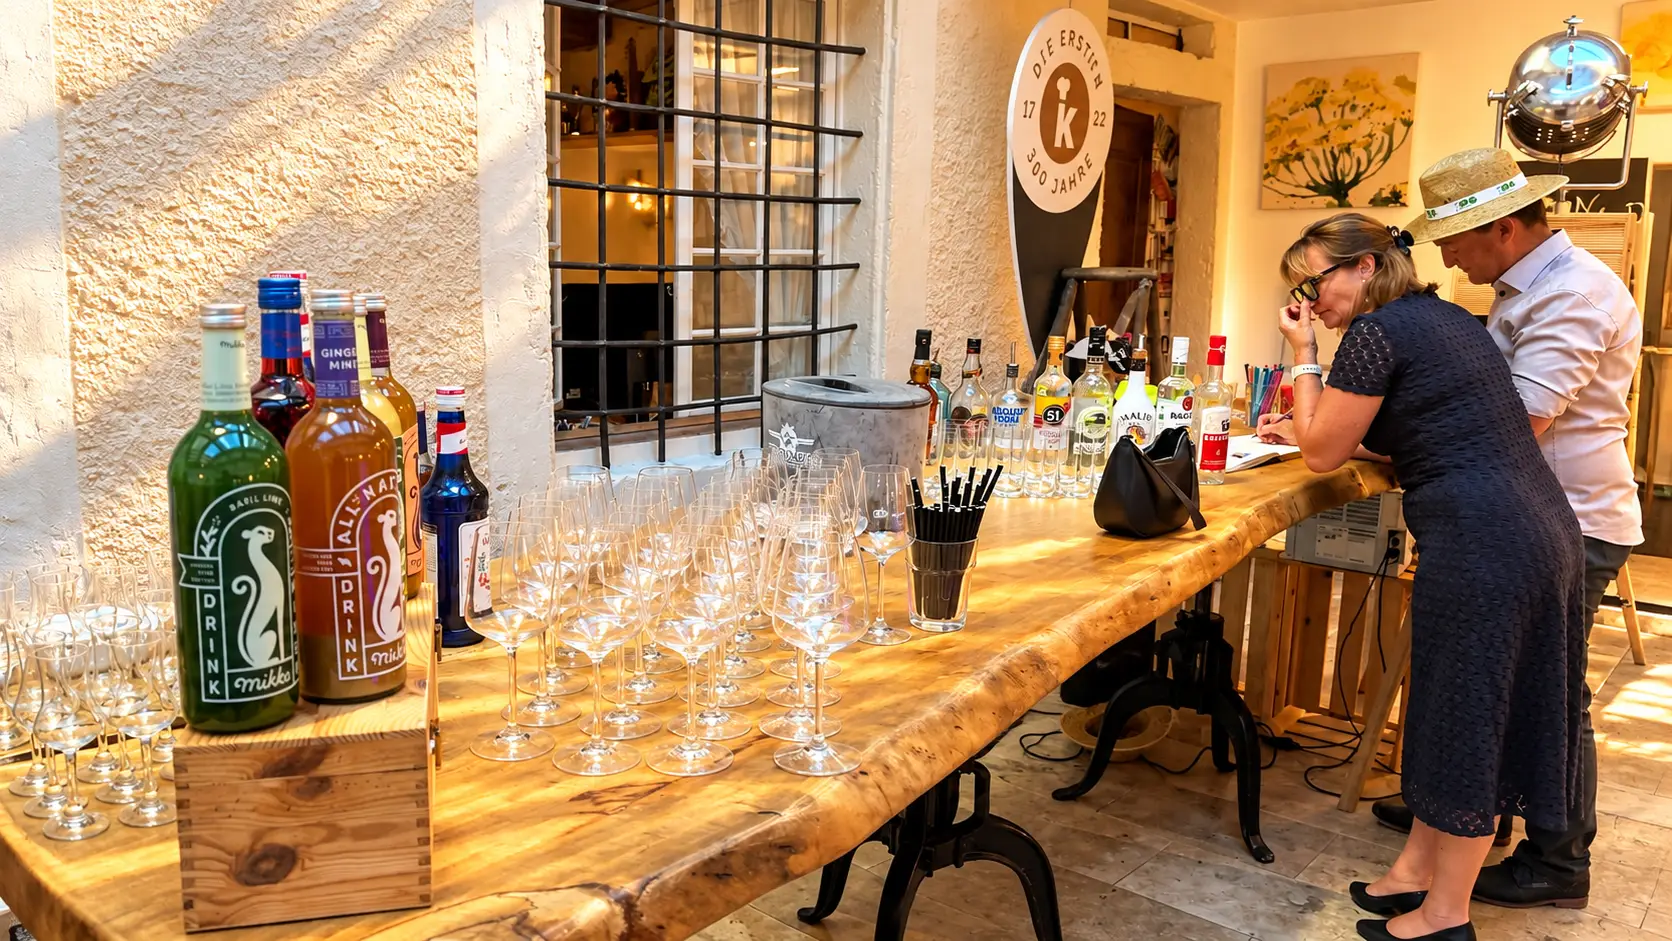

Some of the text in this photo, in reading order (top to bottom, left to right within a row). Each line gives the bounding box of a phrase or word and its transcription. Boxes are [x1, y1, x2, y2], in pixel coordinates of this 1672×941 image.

[1033, 38, 1054, 79] DIE
[1023, 100, 1036, 119] 17
[1093, 111, 1106, 127] 22
[1027, 148, 1093, 194] 300 JAHRE
[321, 348, 357, 358] GINGE
[1046, 410, 1060, 421] 51
[341, 579, 359, 673] DRINK
[203, 593, 220, 695] DRINK
